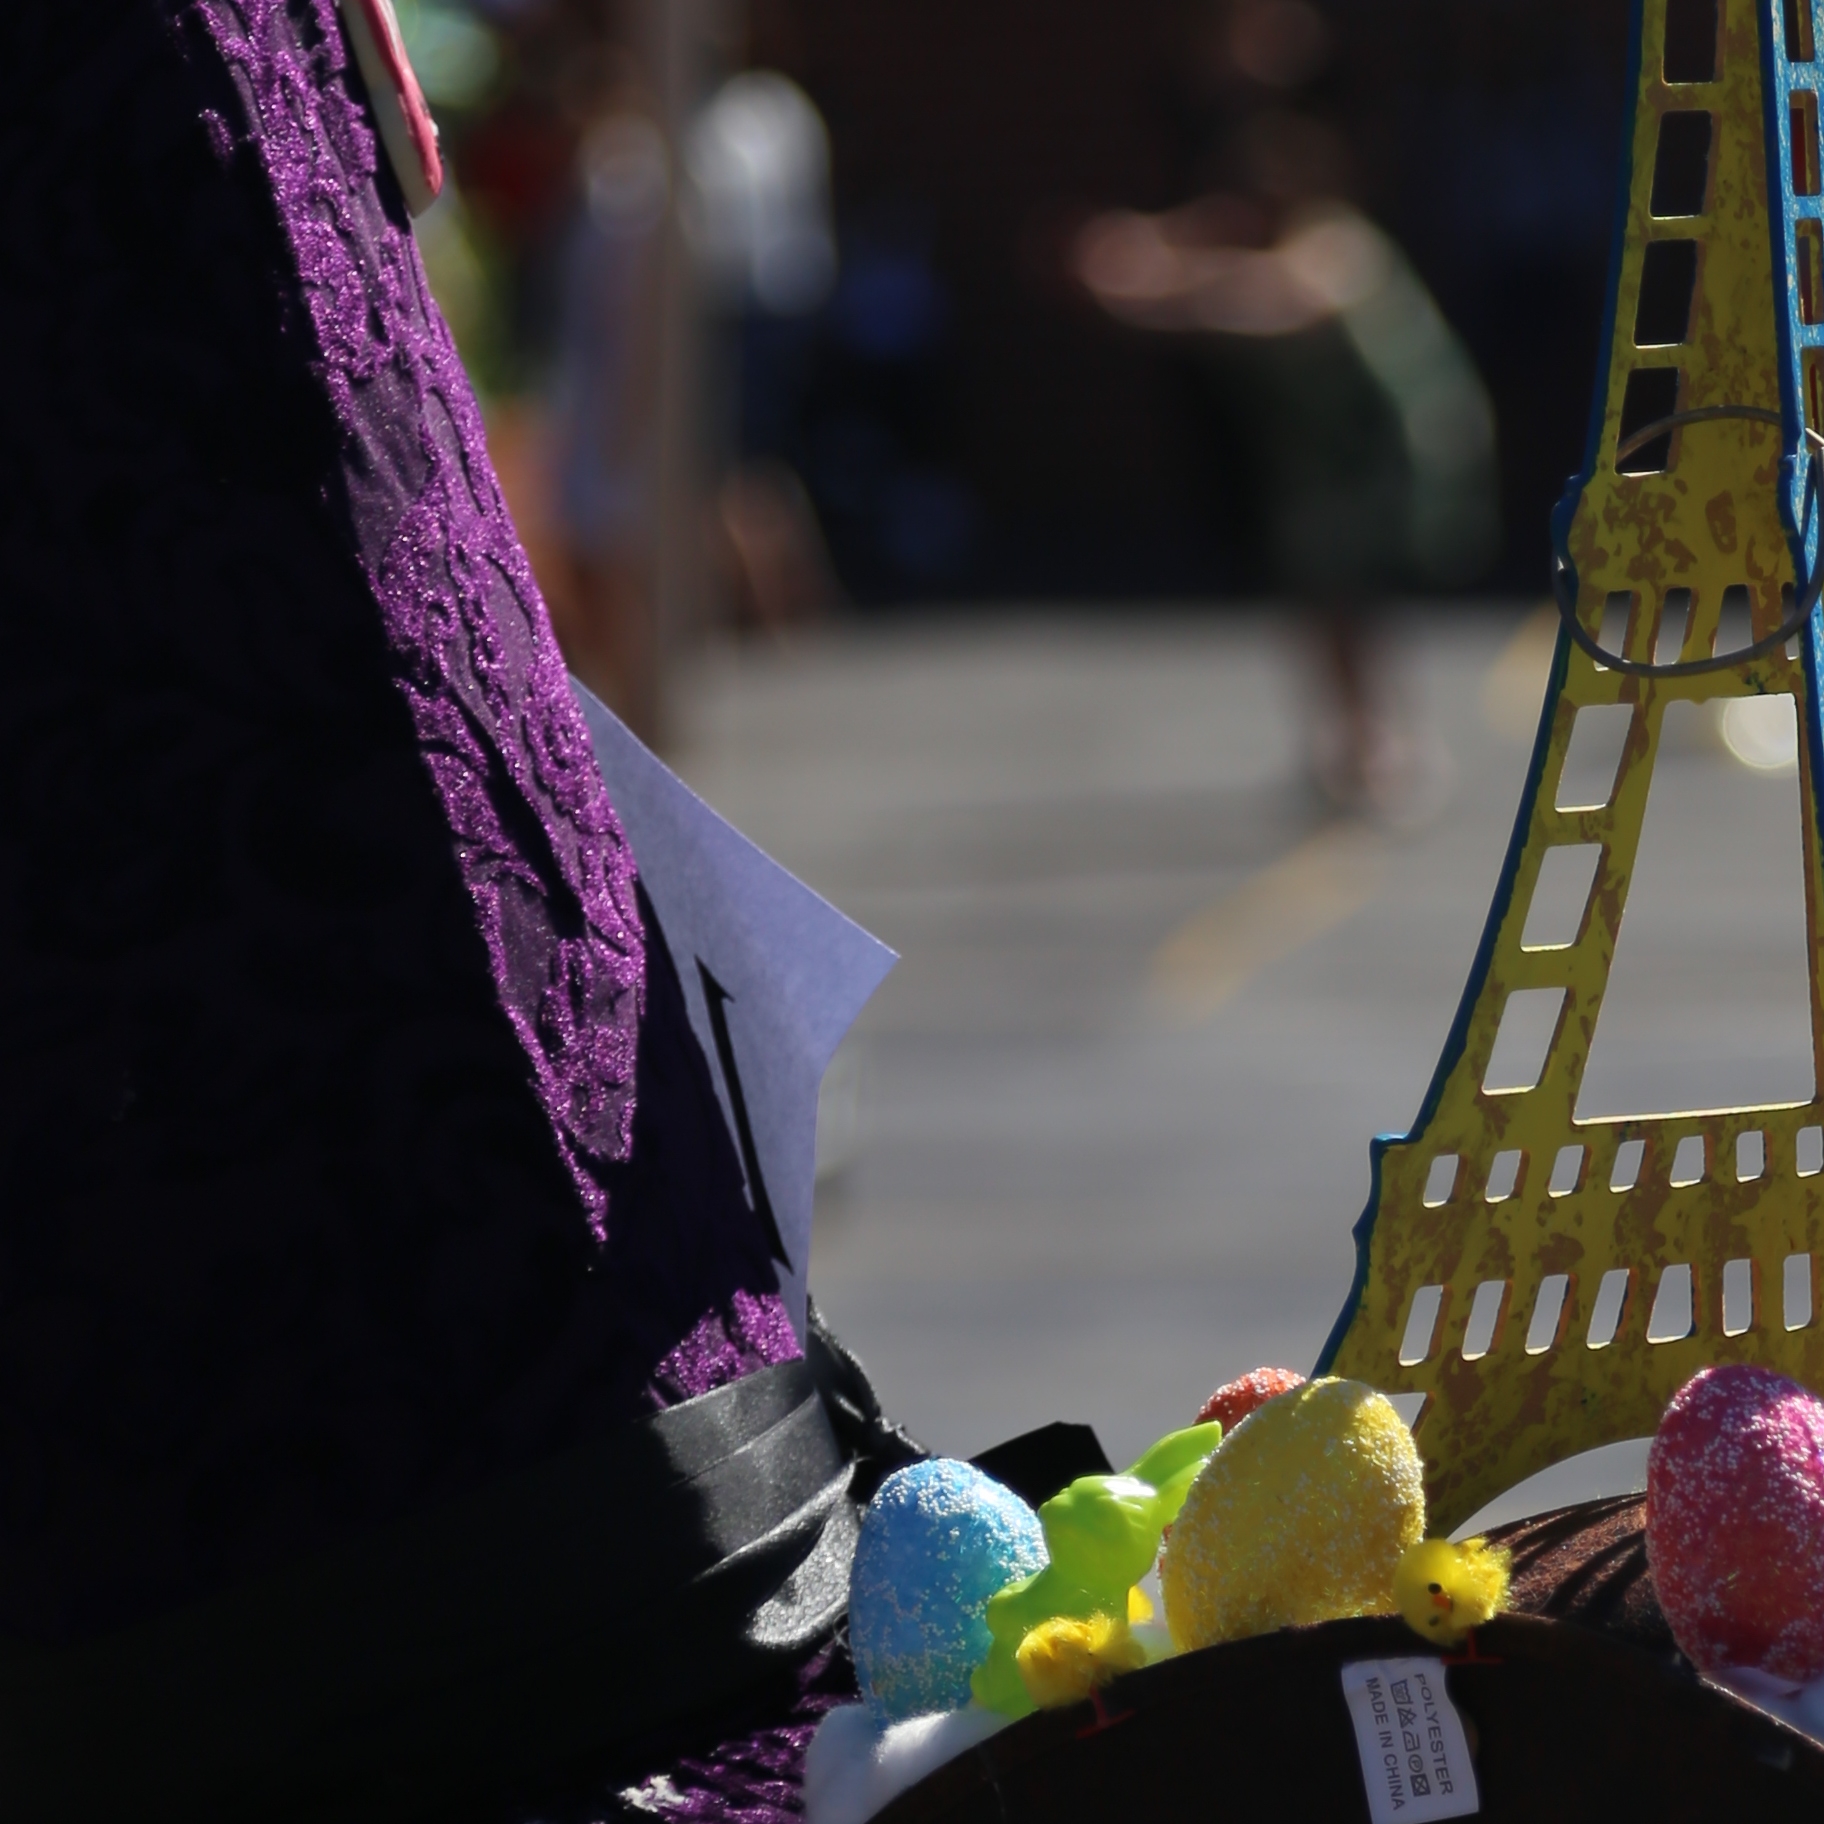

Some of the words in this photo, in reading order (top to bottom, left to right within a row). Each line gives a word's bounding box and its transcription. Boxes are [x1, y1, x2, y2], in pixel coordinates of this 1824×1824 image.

[1366, 1677, 1389, 1725] MADE
[1378, 1730, 1394, 1748] IN
[1415, 1673, 1454, 1795] POLYESTER
[1383, 1754, 1406, 1811] CHINA
